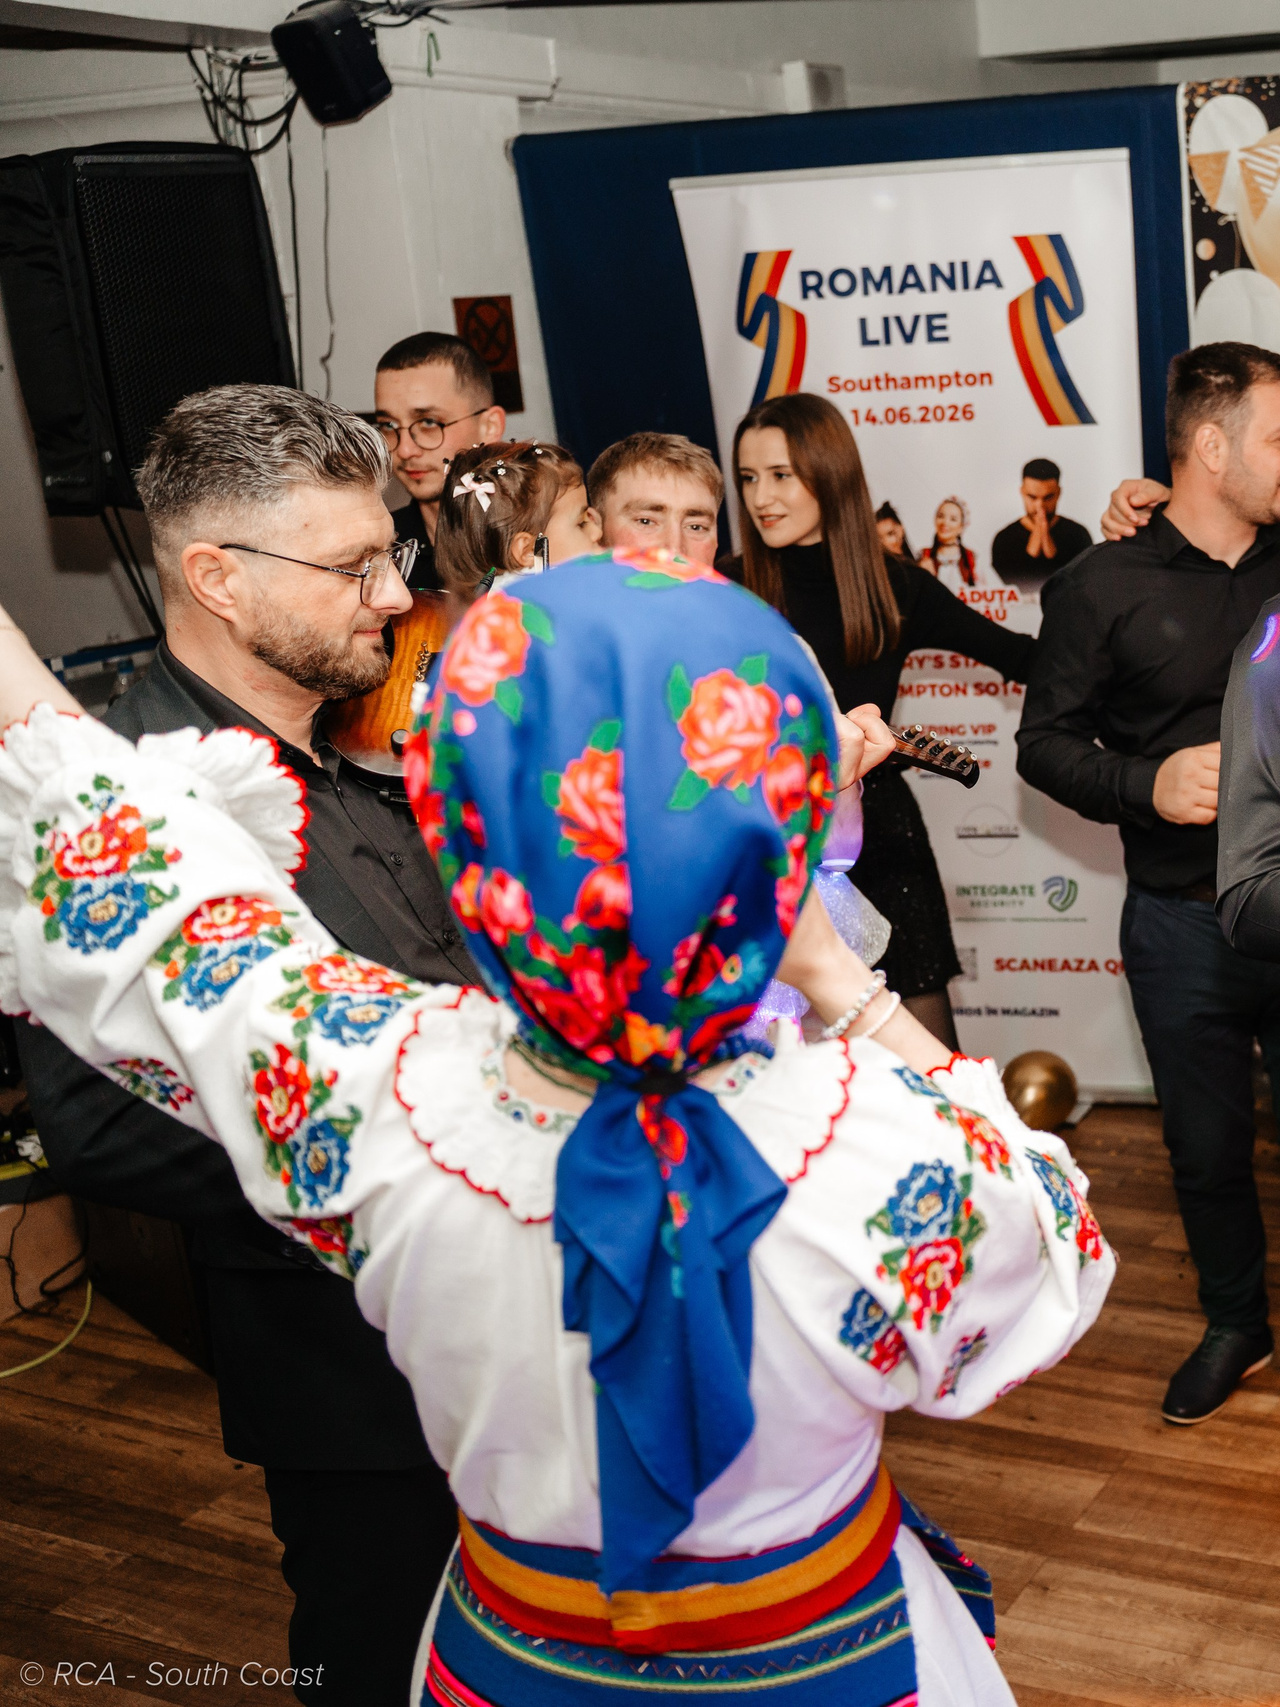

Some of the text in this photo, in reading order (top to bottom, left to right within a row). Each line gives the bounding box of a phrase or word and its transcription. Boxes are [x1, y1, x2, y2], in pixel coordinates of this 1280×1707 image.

[799, 259, 1004, 300] ROMANIA
[858, 312, 951, 348] LIVE
[827, 370, 994, 395] Southampton
[851, 403, 976, 428] 14.06.2026
[897, 682, 968, 699] MPTON
[955, 884, 1036, 898] INTEGRATE
[994, 957, 1100, 974] SCANEAZA
